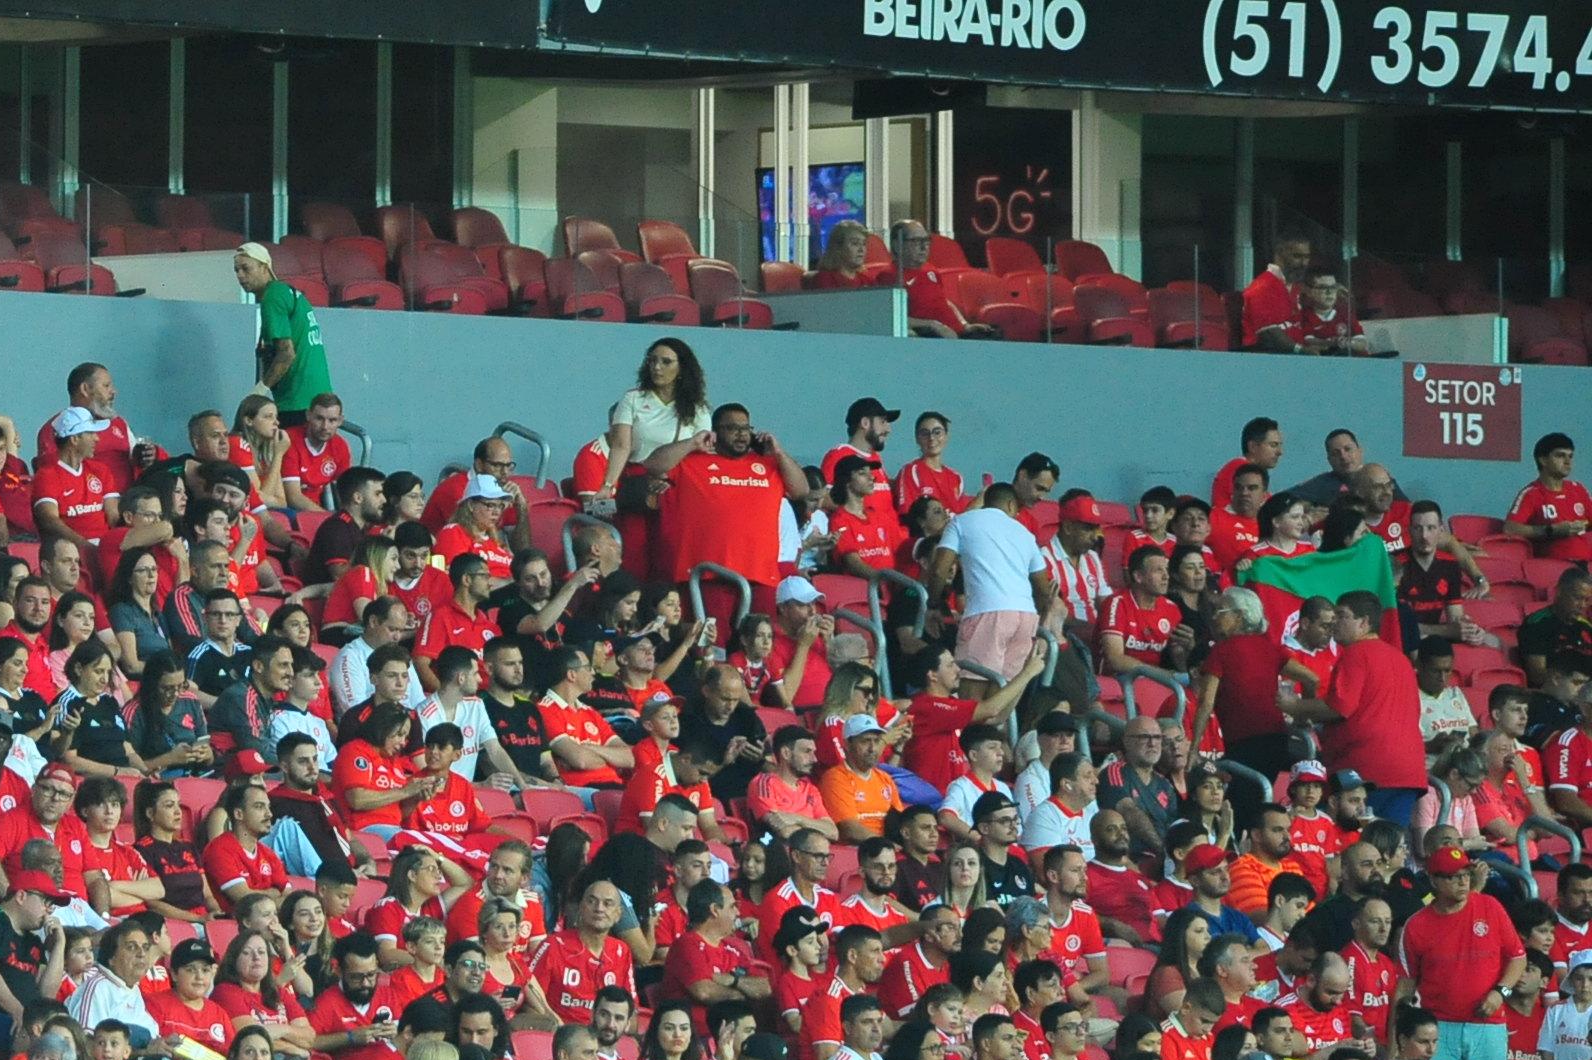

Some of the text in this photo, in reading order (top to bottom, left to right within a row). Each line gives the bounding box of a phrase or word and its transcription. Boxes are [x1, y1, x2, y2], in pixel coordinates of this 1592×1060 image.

[1203, 0, 1342, 93] (51)
[971, 175, 1035, 235] 5G
[1425, 379, 1496, 406] SETOR
[1439, 411, 1485, 446] 115
[721, 476, 769, 488] Banrisul
[562, 968, 580, 987] 10
